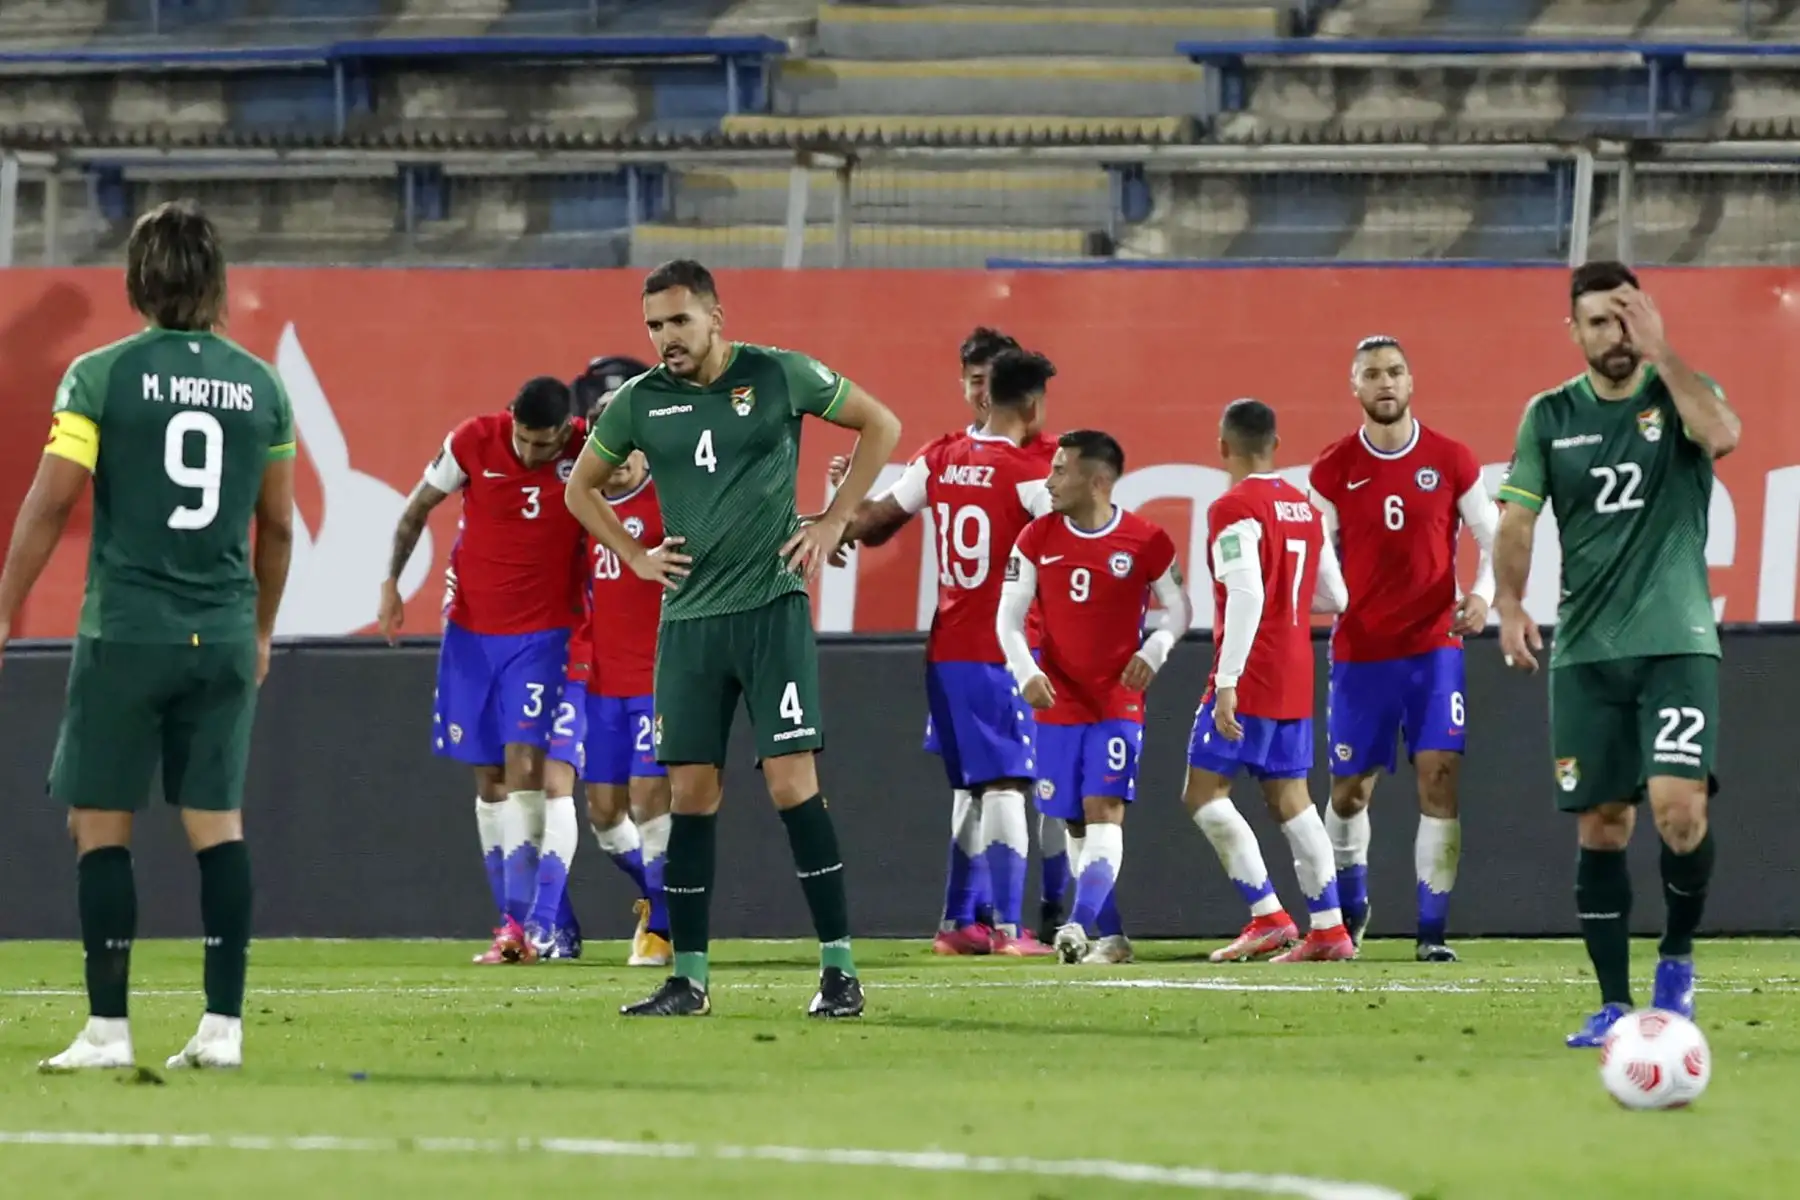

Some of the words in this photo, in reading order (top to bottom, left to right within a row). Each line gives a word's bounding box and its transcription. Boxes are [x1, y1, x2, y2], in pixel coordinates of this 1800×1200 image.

[142, 373, 164, 401] M.
[170, 375, 253, 411] MARTINS
[649, 404, 692, 417] marathon
[694, 429, 717, 473] 4
[164, 411, 224, 530] 9
[939, 464, 995, 488] JIMENEZ
[1589, 462, 1645, 514] 22
[521, 486, 541, 519] 3
[1384, 494, 1404, 531] 6
[593, 543, 621, 580] 20
[937, 502, 991, 590] 19
[1069, 567, 1091, 602] 9
[1286, 538, 1307, 626] 7
[523, 682, 545, 718] 3
[780, 681, 803, 725] 4
[1450, 691, 1465, 726] 6
[553, 702, 576, 737] 2
[636, 715, 656, 751] 2
[1653, 706, 1705, 755] 22
[1107, 737, 1126, 771] 9
